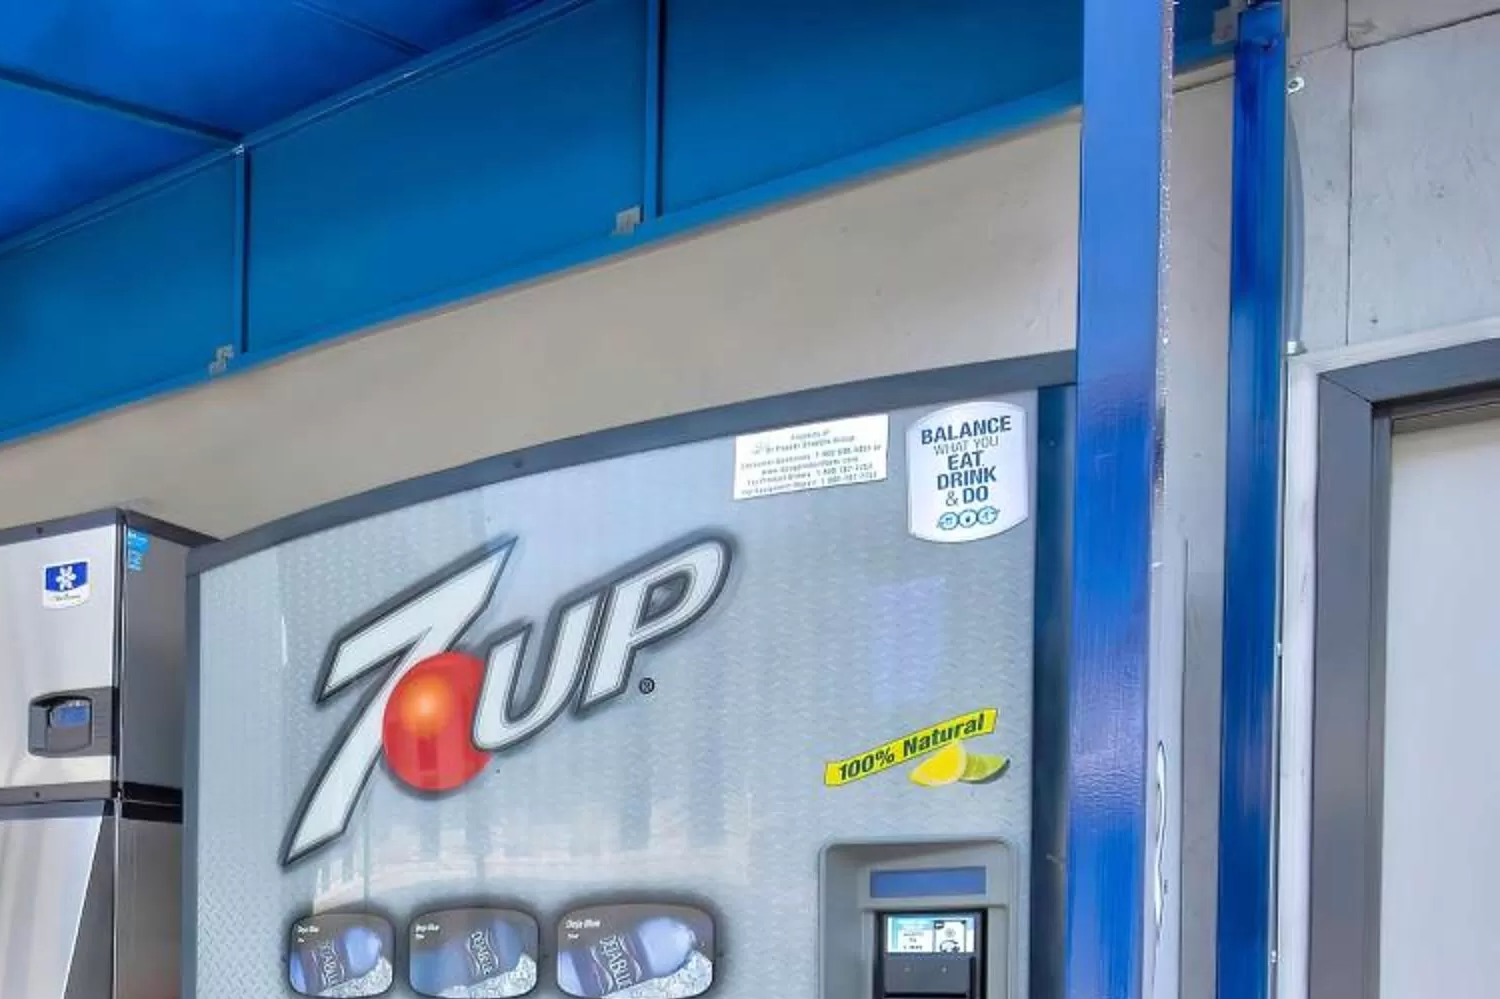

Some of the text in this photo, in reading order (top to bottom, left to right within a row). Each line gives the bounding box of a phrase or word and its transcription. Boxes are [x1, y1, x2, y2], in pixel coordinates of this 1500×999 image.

[921, 415, 1012, 445] BALANCE
[933, 435, 999, 456] WHAT YOU
[937, 465, 997, 491] DRINK
[945, 485, 989, 507] & DO
[838, 712, 985, 781] 100% Natural
